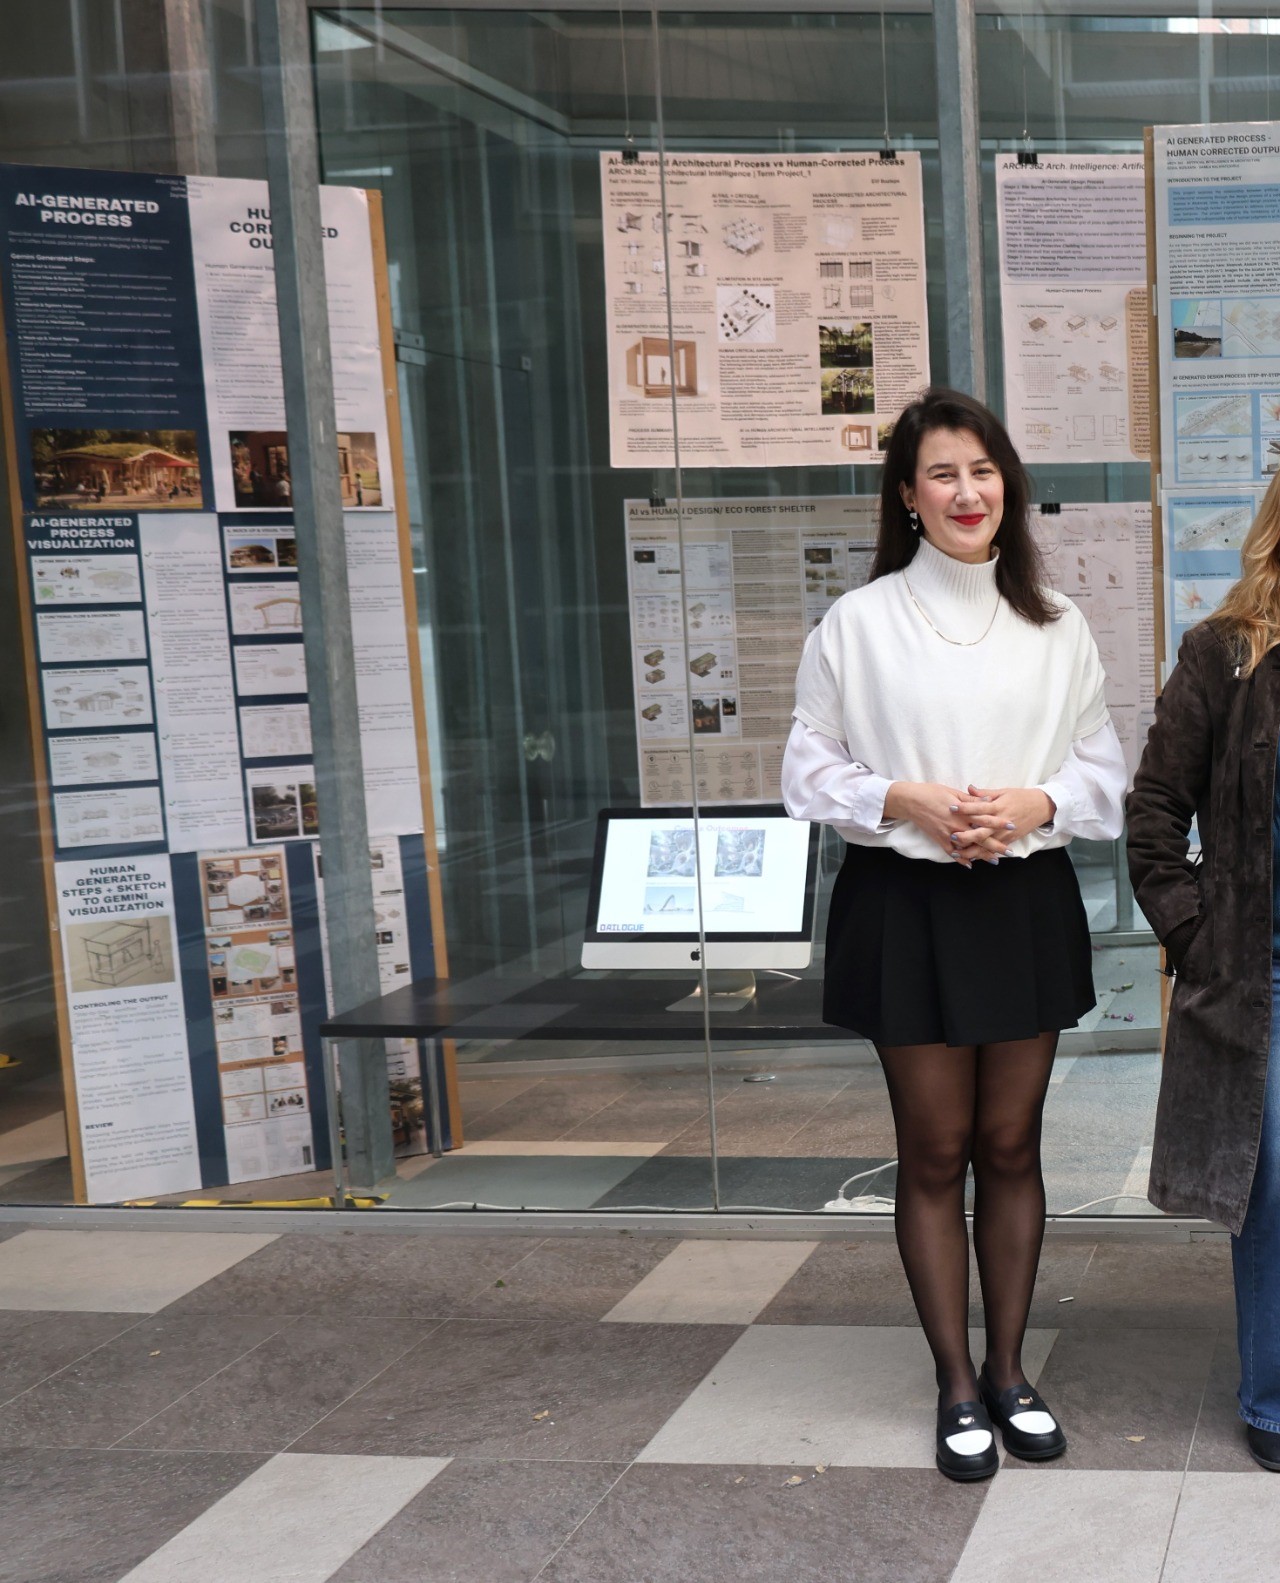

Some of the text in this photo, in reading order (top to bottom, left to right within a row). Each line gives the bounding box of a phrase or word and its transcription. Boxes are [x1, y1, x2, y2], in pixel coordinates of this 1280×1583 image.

[1178, 136, 1226, 145] GENERATED
[1228, 135, 1266, 143] PROCESS
[1167, 148, 1198, 157] HUMAN
[1200, 147, 1250, 156] CORRECTED
[608, 158, 668, 166] AI-Generatd
[672, 159, 731, 168] Architectural
[734, 160, 770, 168] Process
[787, 159, 866, 167] Human-Corrected
[868, 158, 905, 166] Process
[1070, 163, 1119, 171] Intelligence:
[15, 193, 159, 213] AI-GENERATED
[41, 210, 132, 227] PROCESS
[629, 508, 639, 516] AI
[687, 506, 724, 516] DESIGN/
[726, 506, 743, 514] ECO
[745, 505, 777, 514] FOREST
[780, 505, 816, 513] SHELTER
[31, 517, 132, 528] AI-GENERATED
[50, 528, 115, 538] PROCESS
[28, 539, 135, 549] VISUALIZATION
[90, 865, 136, 876] HUMAN
[76, 873, 151, 886] GENERATED
[62, 882, 166, 898] STEPS SKETCH
[83, 893, 148, 905] TO GEMINI
[69, 901, 164, 916] VISUALIZATION
[73, 999, 121, 1010] CONTROLING
[139, 995, 168, 1003] OUTPUT
[85, 1122, 113, 1130] REVIEW
